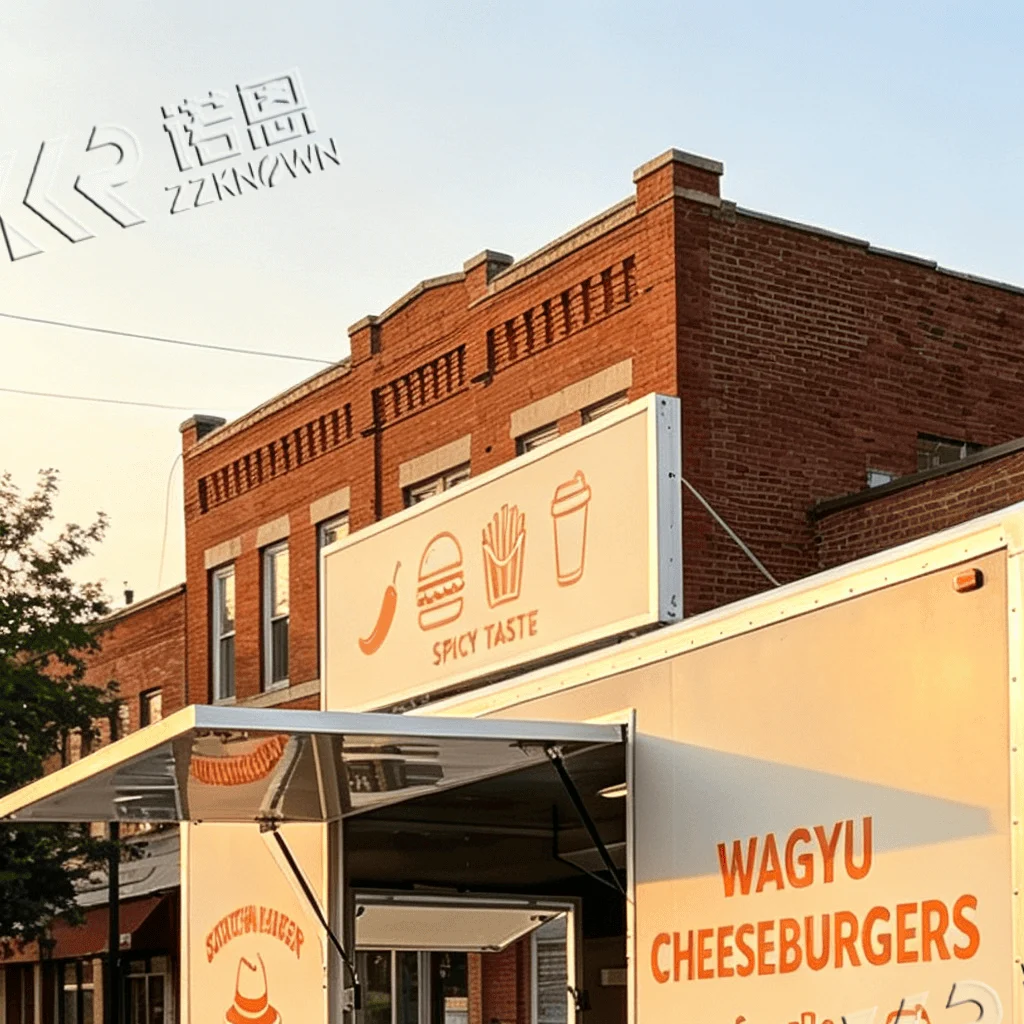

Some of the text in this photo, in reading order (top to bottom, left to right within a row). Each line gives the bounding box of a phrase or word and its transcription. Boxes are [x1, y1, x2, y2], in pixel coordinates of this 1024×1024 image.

[432, 609, 539, 666] SPICY TASTE
[717, 816, 873, 898] WAGYU
[650, 894, 981, 984] CHEESEBURGERS
